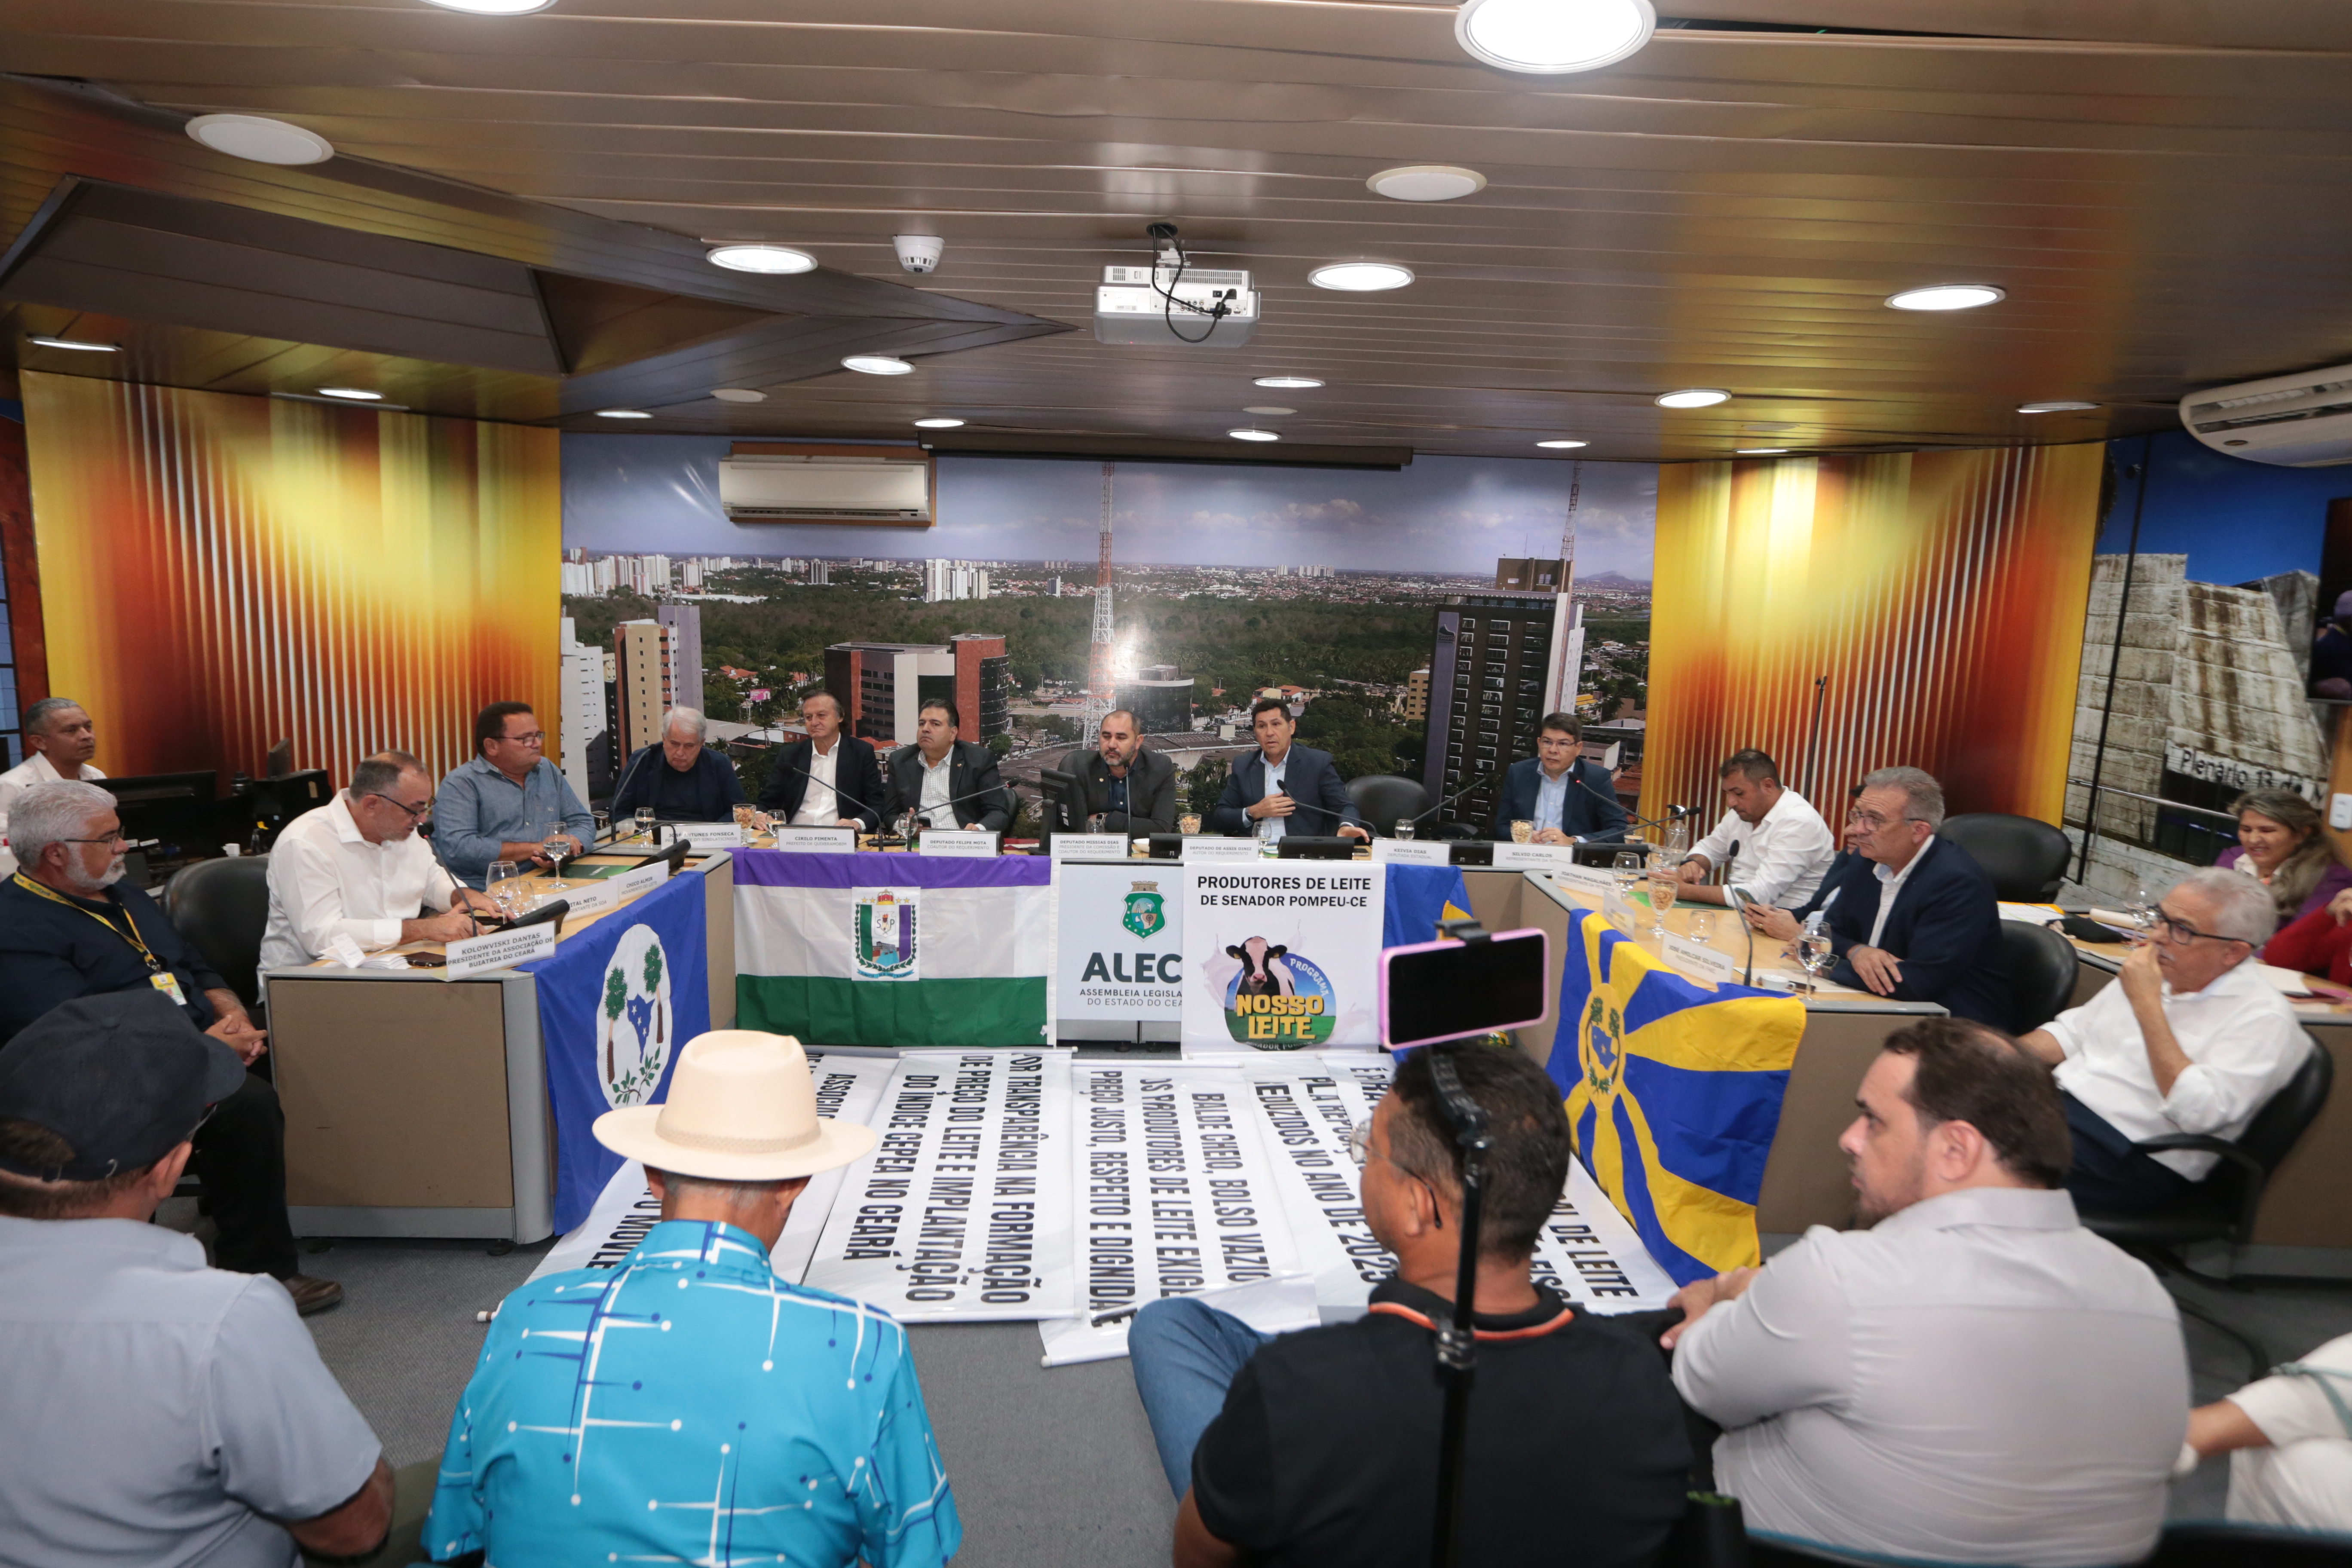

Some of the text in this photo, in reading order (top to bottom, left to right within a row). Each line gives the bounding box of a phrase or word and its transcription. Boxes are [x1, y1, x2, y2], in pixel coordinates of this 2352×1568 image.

[1197, 876, 1371, 890] PRODUTORES DE LEITE
[1201, 895, 1367, 907] DE SENADOR POMPEU-CE
[448, 951, 490, 965] PRESIDENTE
[503, 939, 543, 953] ASSOCIAÇÃO
[462, 933, 540, 955] KOLOWVISKI DANTAS
[469, 956, 501, 968] BUIATRIA
[514, 947, 535, 957] CEARÁ
[1081, 952, 1182, 983] ALEC
[1290, 958, 1329, 997] PROGRAMA
[1080, 989, 1140, 997] ASSEMBLEIA
[1237, 994, 1324, 1017] NOSSO
[1248, 1016, 1316, 1039] LEITE
[959, 1055, 994, 1067] DE
[902, 1075, 940, 1088] DO
[945, 1070, 992, 1102] PREÇO
[1079, 1071, 1124, 1103] PREÇO
[1140, 1078, 1174, 1092] OS
[947, 1107, 985, 1122] DO
[997, 1075, 1049, 1171] TRANSPARÊNCIA
[1254, 1082, 1320, 1145] EDUZIDOS
[1086, 1107, 1127, 1147] JUSTO,
[1142, 1094, 1186, 1172] PRODUTORES
[872, 1133, 923, 1173] CEPEA
[938, 1127, 982, 1160] LEITE
[1289, 1149, 1334, 1167] NO
[864, 1179, 911, 1198] NO
[994, 1177, 1036, 1196] NA
[1090, 1152, 1131, 1216] RESPEITO
[1150, 1177, 1191, 1194] DE
[1191, 1093, 1272, 1282] BALDE CHEIO, BOLSO VAZIO
[1302, 1173, 1356, 1201] ANO
[1090, 1222, 1132, 1231] E
[1152, 1200, 1197, 1241] LEITE
[1322, 1207, 1368, 1227] DE
[842, 1205, 903, 1260] CEARÁ
[895, 1177, 974, 1301] IMPLANTAÇÃO
[1548, 1225, 1602, 1244] DE
[968, 1202, 1042, 1303] FORMAÇÃO
[1565, 1250, 1640, 1297] LEITE
